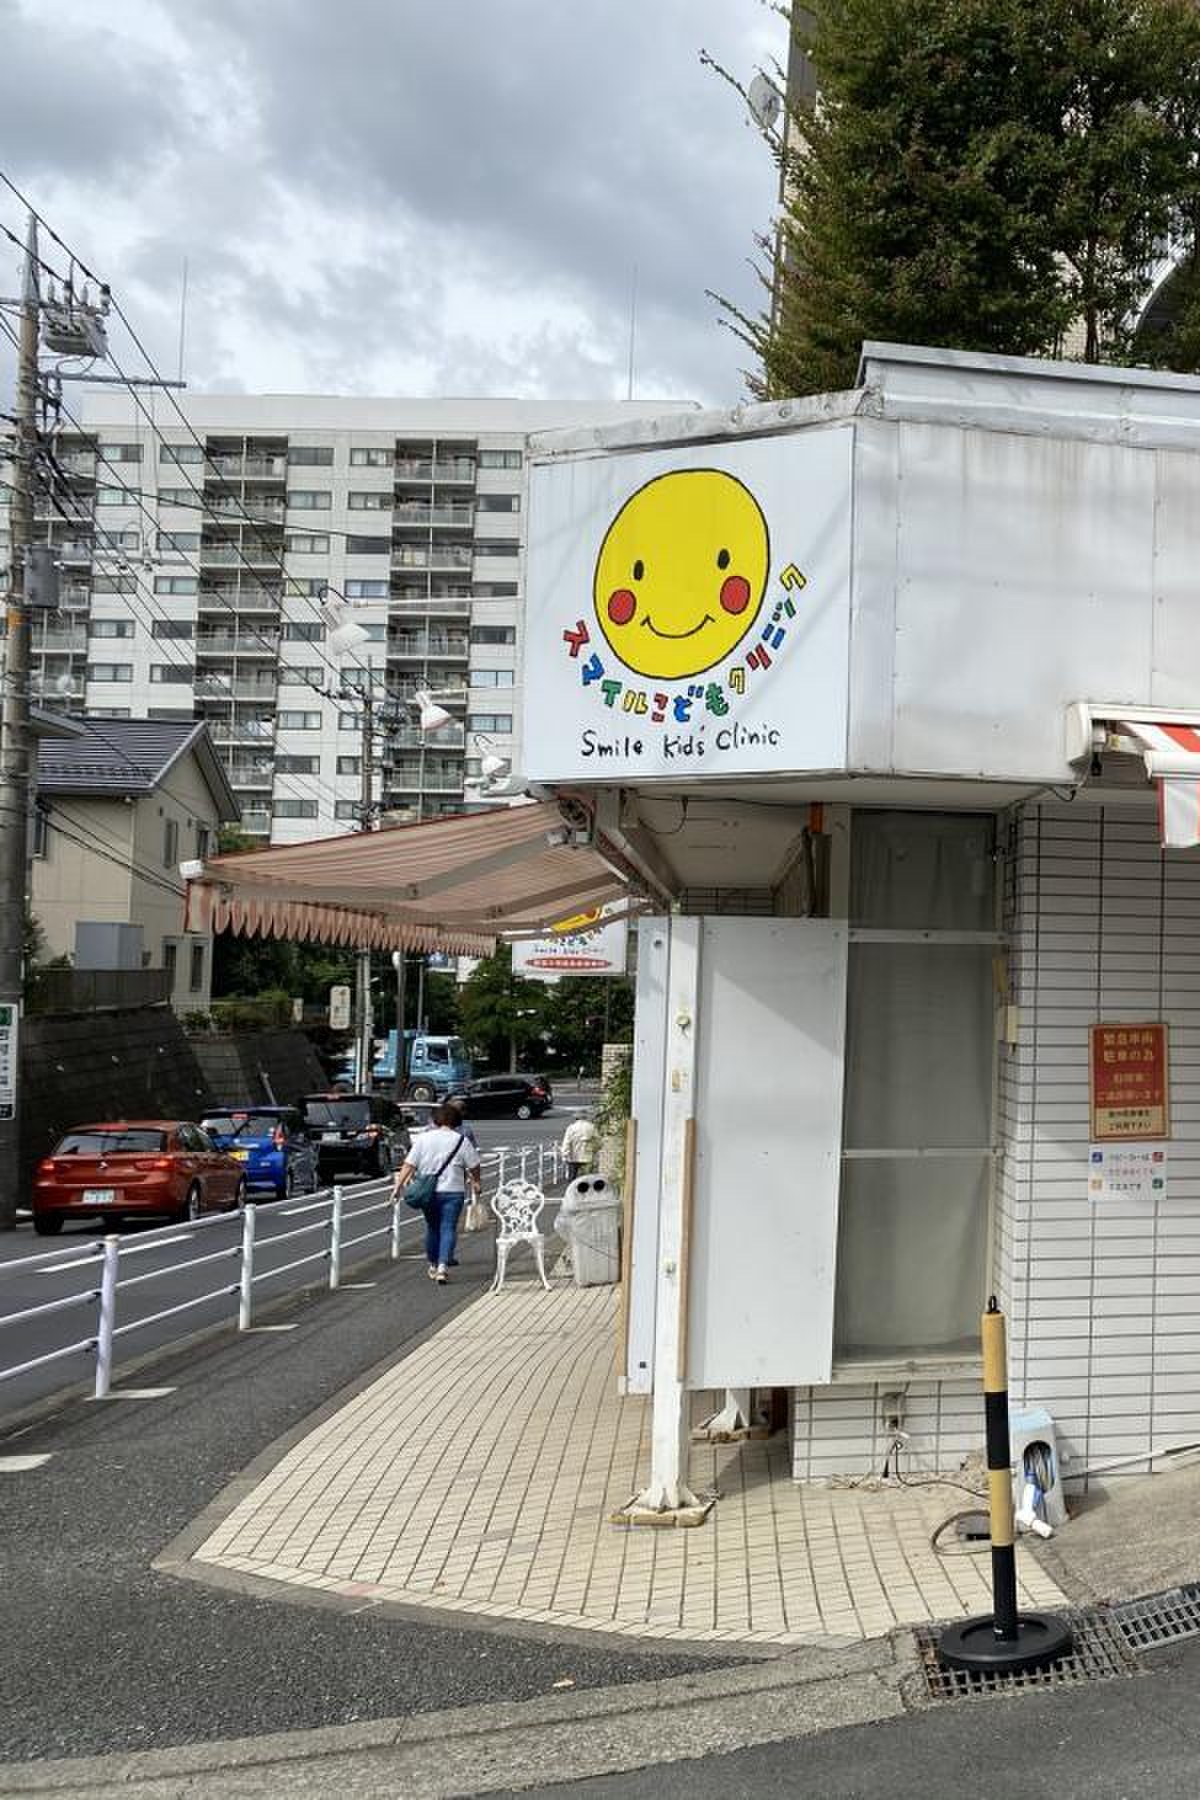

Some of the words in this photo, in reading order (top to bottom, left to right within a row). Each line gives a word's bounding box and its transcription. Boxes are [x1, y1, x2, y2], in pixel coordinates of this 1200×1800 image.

[563, 563, 807, 723] スマイルこどもクリニック
[581, 729, 644, 757] Smile
[715, 721, 781, 750] Clinic
